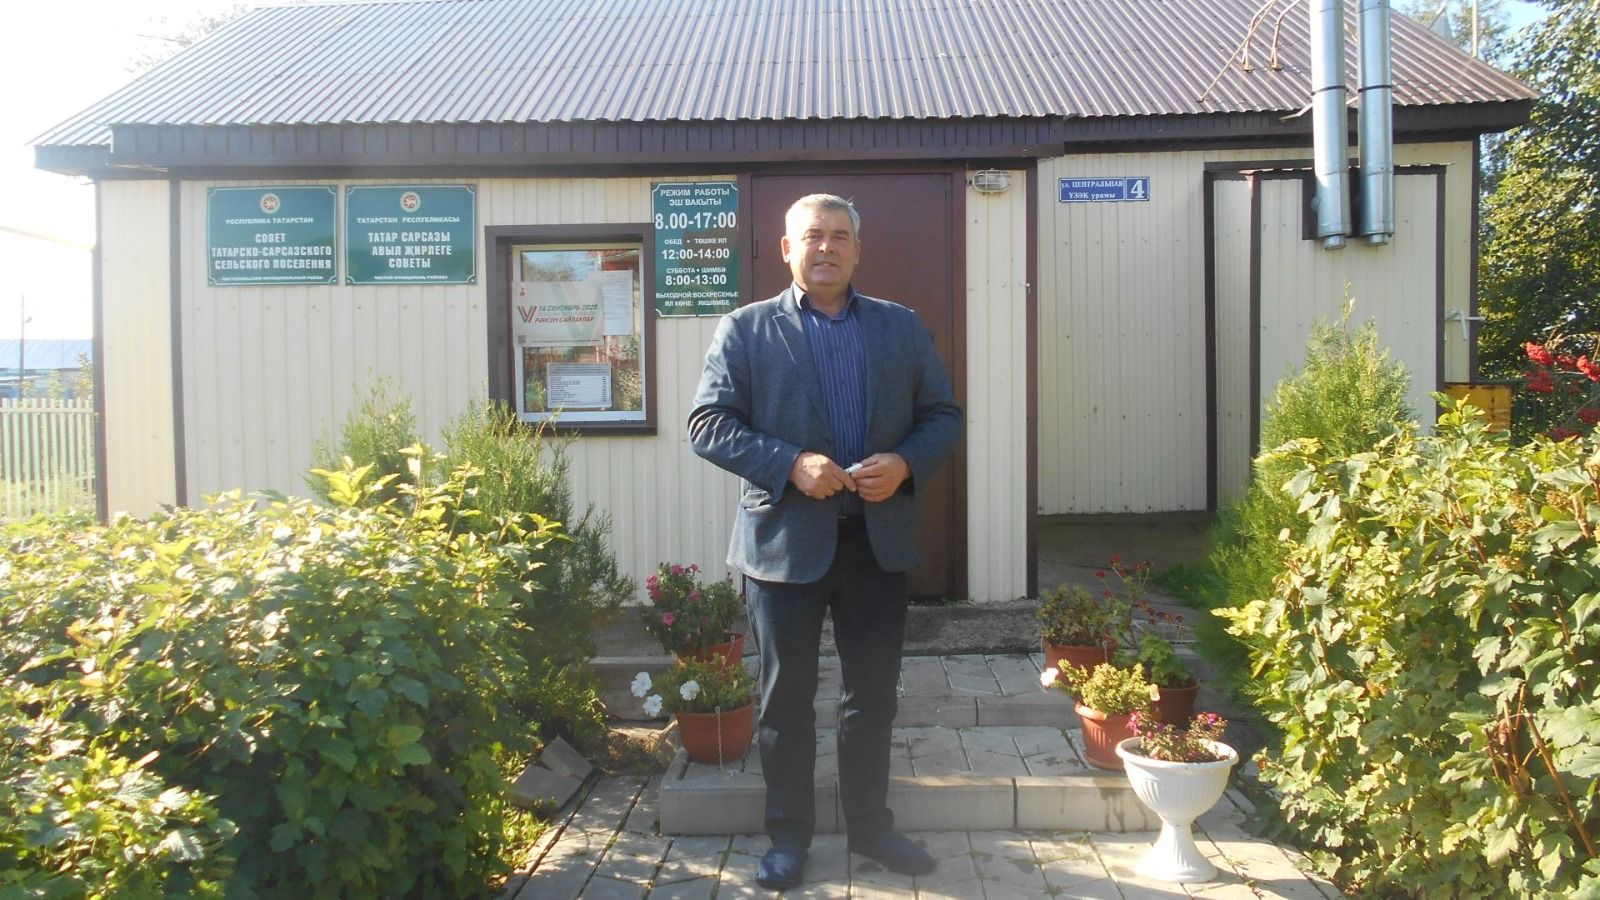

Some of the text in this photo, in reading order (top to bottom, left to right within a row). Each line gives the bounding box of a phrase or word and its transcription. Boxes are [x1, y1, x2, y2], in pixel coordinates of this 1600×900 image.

[1130, 180, 1145, 198] 4
[655, 212, 737, 230] 8.00-17:00
[255, 233, 287, 242] СОВЕТ
[368, 232, 450, 242] ТАТАР САРСАЗЫ
[211, 246, 332, 256] ТАТАРСКО-САРСАЗСКОГО
[372, 246, 452, 257] АВЫЛ ҖИРЛЕГЕ
[662, 248, 730, 260] 12:00-14:00
[215, 260, 332, 270] СЕЛЬСКОГО ПОСЕЛЕНИЯ
[389, 258, 430, 268] СОВЕТЫ
[665, 274, 727, 286] 8:00-13:00
